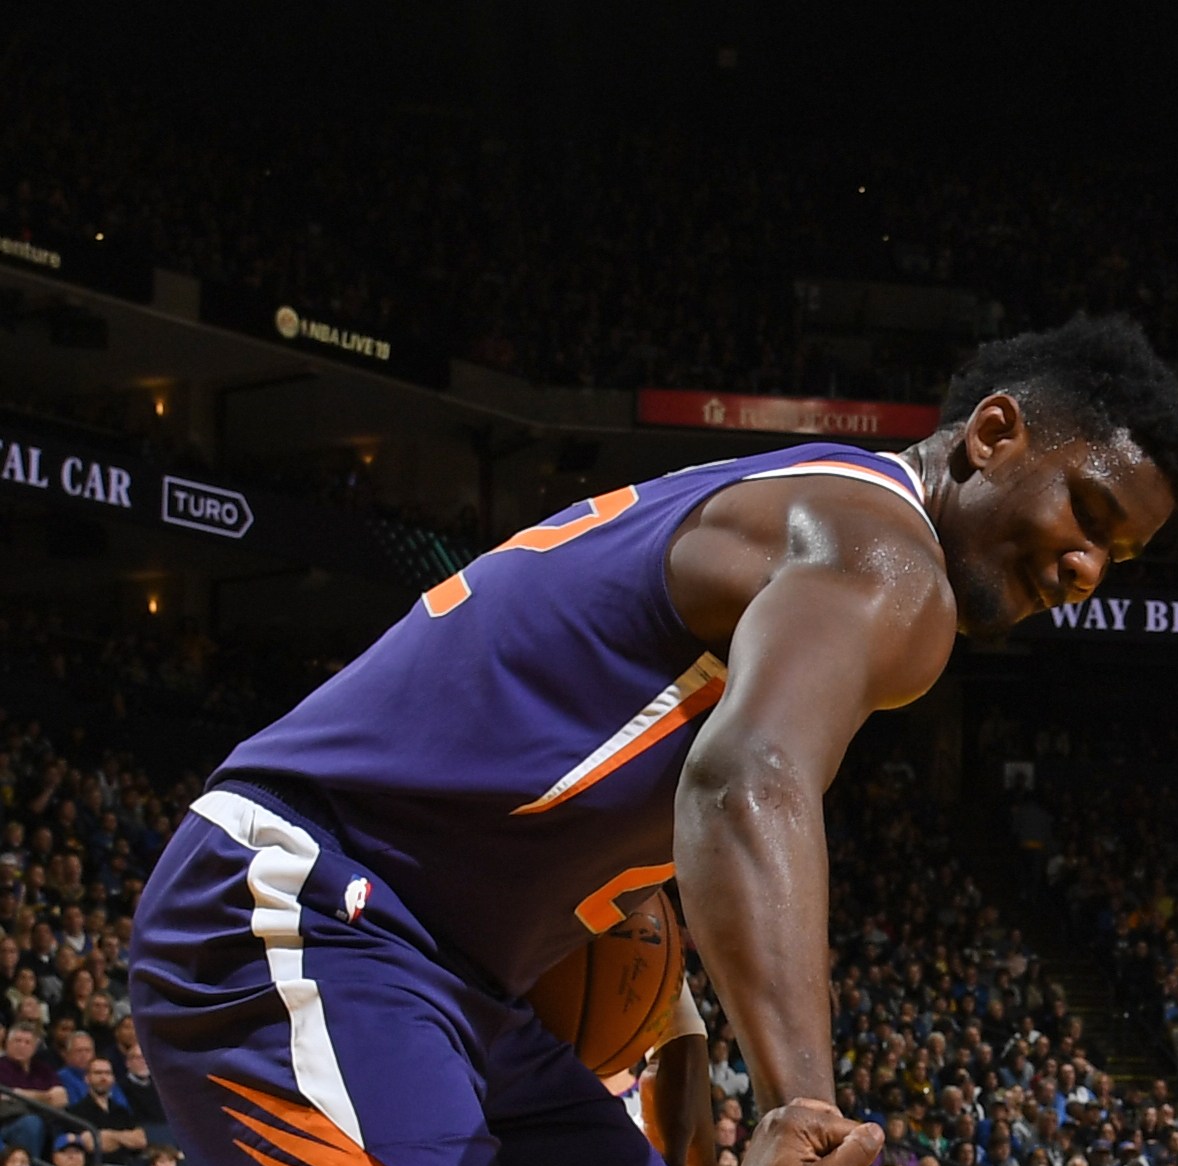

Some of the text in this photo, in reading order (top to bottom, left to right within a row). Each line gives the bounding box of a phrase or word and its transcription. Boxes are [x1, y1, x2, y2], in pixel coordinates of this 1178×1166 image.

[0, 438, 133, 509] AL CAR
[172, 489, 239, 526] TURO
[1050, 597, 1132, 631] WAY
